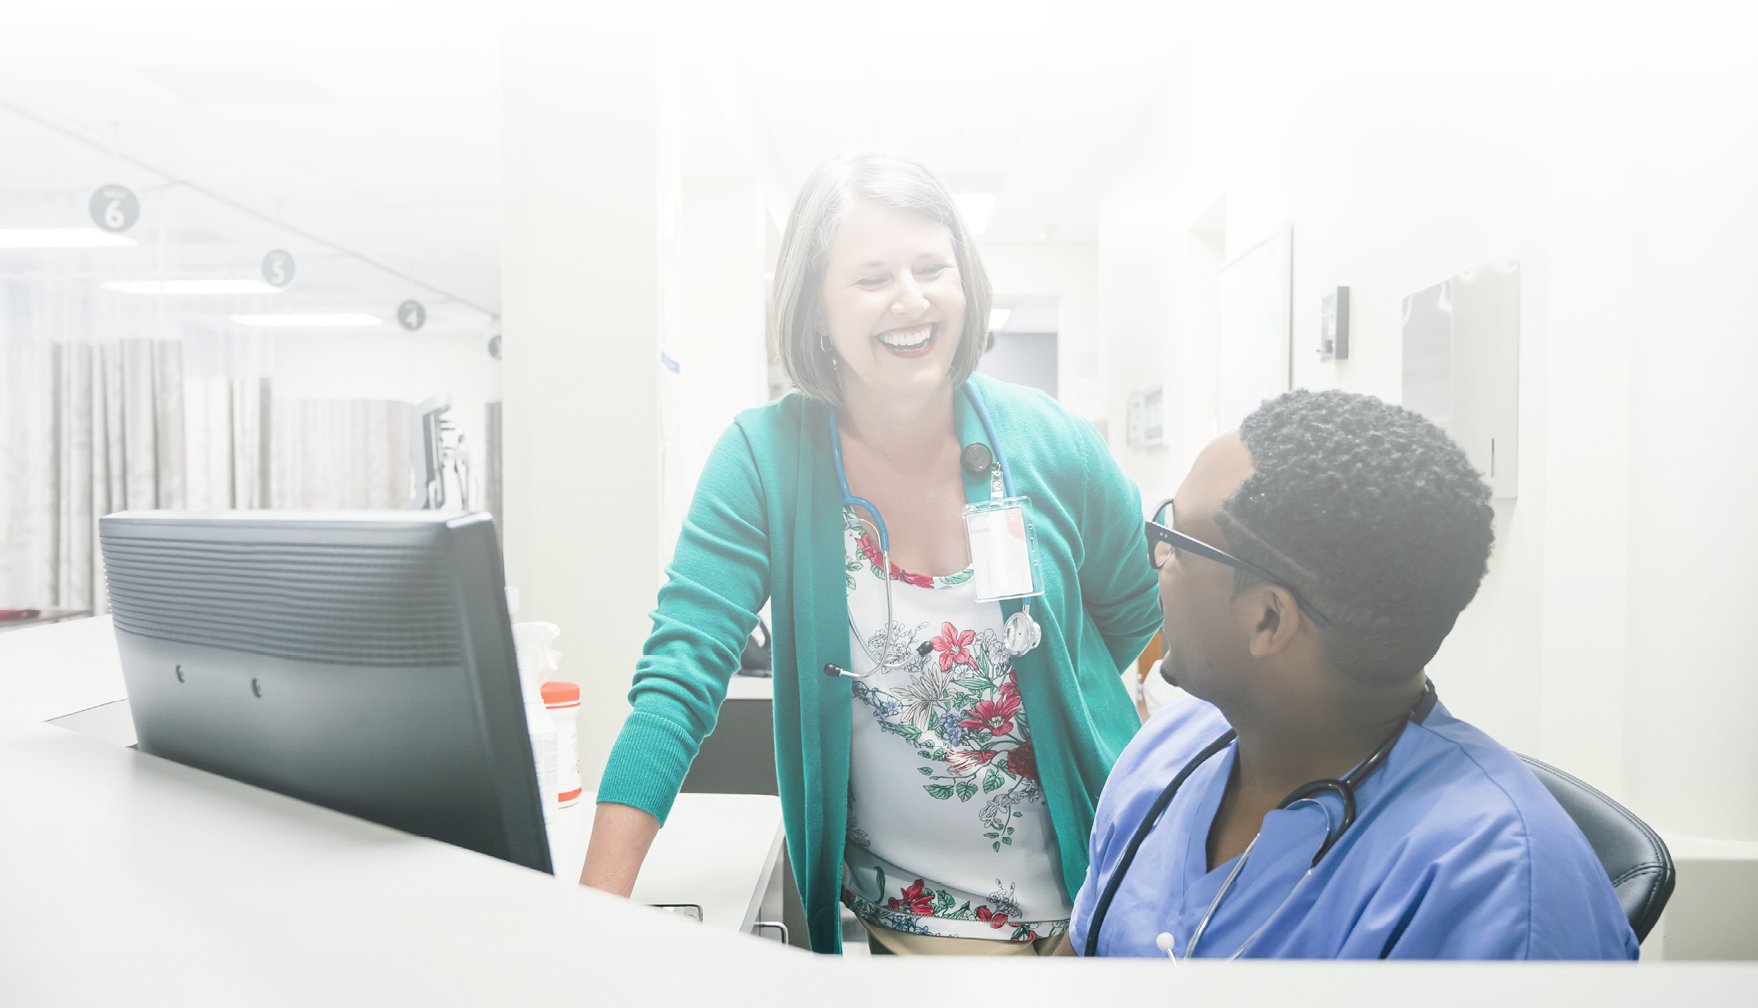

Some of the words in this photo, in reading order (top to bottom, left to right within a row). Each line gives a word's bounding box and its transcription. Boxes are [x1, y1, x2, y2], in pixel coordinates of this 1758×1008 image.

[105, 200, 125, 229] 6
[272, 260, 285, 284] 5
[406, 309, 418, 328] 4
